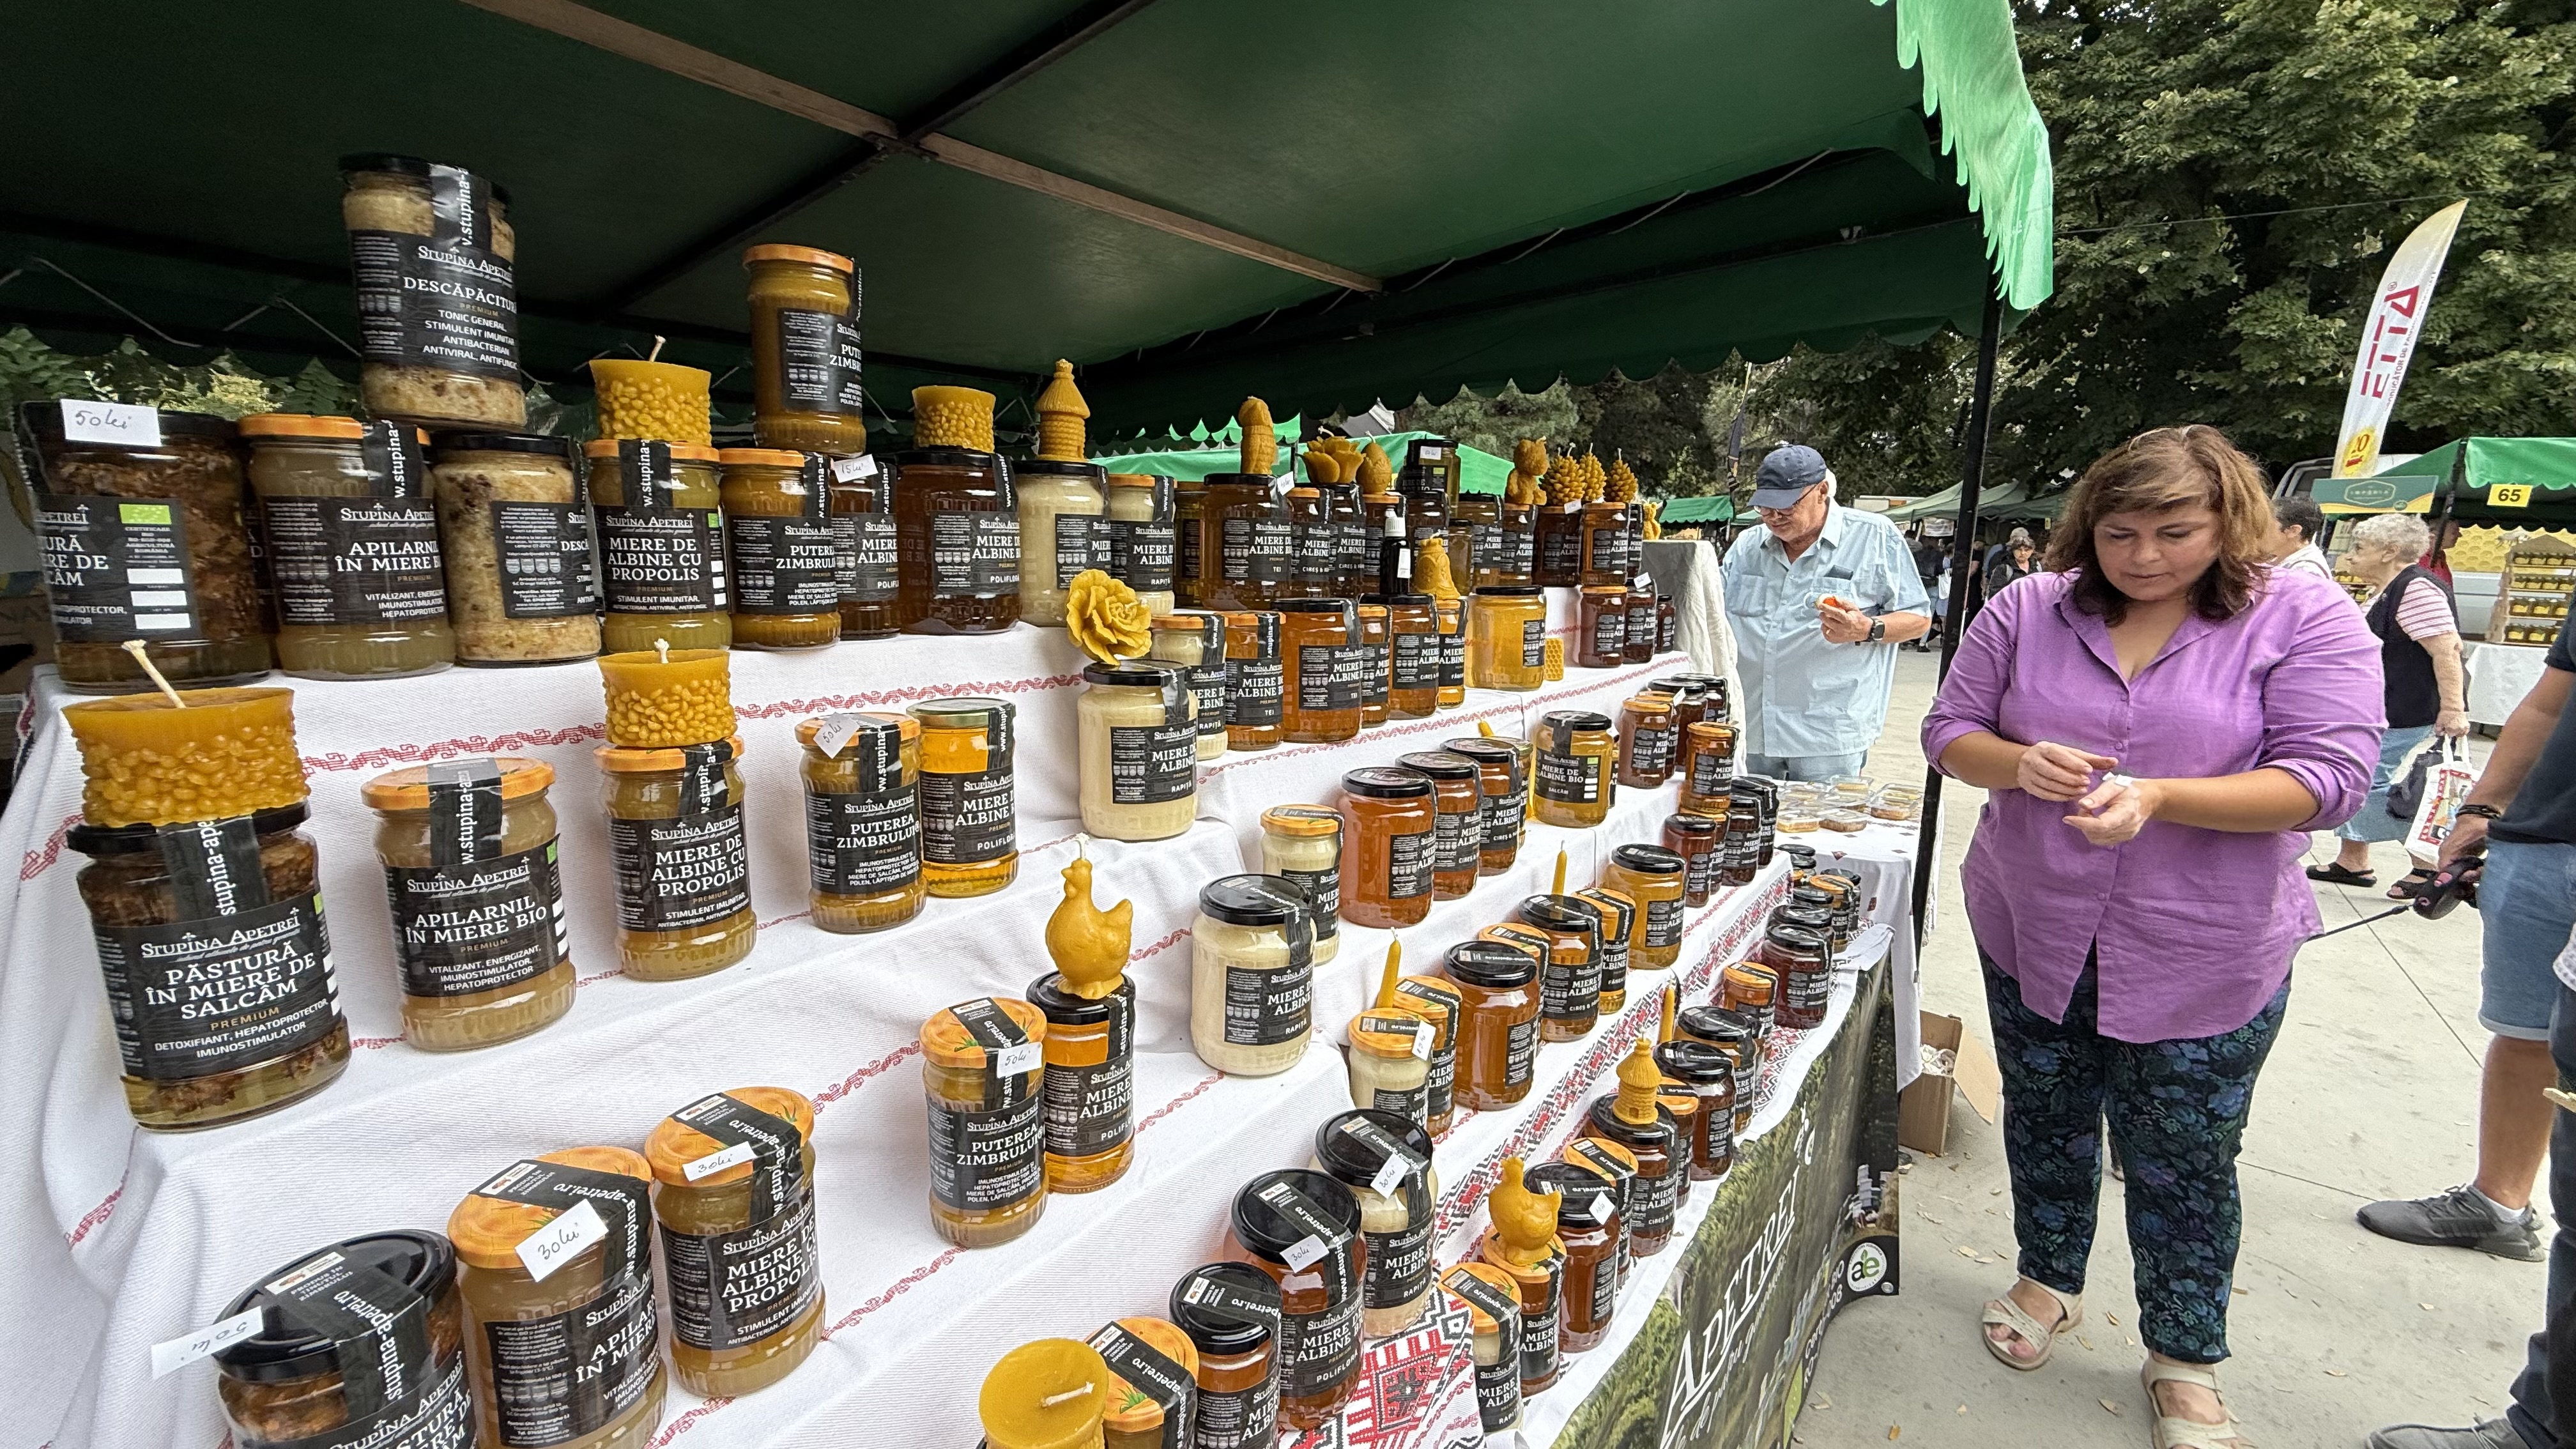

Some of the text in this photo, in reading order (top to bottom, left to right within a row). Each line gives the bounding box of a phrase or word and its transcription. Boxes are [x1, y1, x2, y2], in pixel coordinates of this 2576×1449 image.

[438, 310, 469, 322] TONIC
[460, 303, 498, 316] PREMIUM
[425, 321, 482, 337] STIMULENT
[443, 335, 509, 355] ANTIBACTERIAN
[2361, 285, 2419, 399] ETTA
[75, 410, 101, 426] 50
[2498, 489, 2520, 502] 65
[341, 508, 399, 520] STUPINA
[606, 515, 694, 528] STUPINA APETREI
[979, 519, 1005, 528] STUPINA
[610, 537, 696, 551] MIERE DE
[977, 536, 1013, 546] MIERE
[1133, 545, 1167, 554] MIERE
[1249, 546, 1284, 554] ALBINE
[76, 555, 109, 569] DE
[608, 554, 702, 567] ALBINE CU
[972, 548, 1013, 559] ALBINE
[1140, 555, 1172, 564] ALBINE
[335, 556, 429, 571] ÎN MIERE
[613, 568, 699, 581] PROPOLIS
[1334, 663, 1358, 671] MIERE
[1243, 678, 1275, 687] MIERE
[1329, 671, 1360, 682] ALBINE
[1237, 689, 1276, 697] ALBINE
[1154, 731, 1180, 740] STUPINA
[1152, 748, 1187, 762] MIERE
[1160, 757, 1194, 772] ALBINE
[1542, 763, 1565, 774] MIERE
[964, 779, 998, 790] STUPINA
[1540, 771, 1566, 782] ALBINE
[845, 802, 884, 813] STUPINA
[963, 795, 1008, 812] MIERE
[1496, 808, 1517, 817] MIERE
[851, 814, 914, 834] PUTEREA
[955, 808, 1009, 825] ALBINE
[1492, 815, 1518, 825] ALBINE
[651, 815, 739, 839] STUPINA APETREI
[656, 834, 742, 866] MIERE DE
[651, 847, 745, 881] ALBINE CU
[407, 879, 465, 891] STUPINA
[472, 864, 530, 885] APETREI
[658, 863, 745, 897] PROPOLIS
[693, 891, 728, 904] PREMIUM
[415, 896, 535, 928] APILARNIL
[666, 905, 714, 919] STIMULENT
[406, 907, 547, 944] ÎN MIERE BIO
[141, 938, 224, 957] STUPINA
[229, 916, 300, 944] APETREI
[461, 939, 508, 953] PREMIUM
[165, 940, 297, 986] PĂSTURĂ
[145, 953, 316, 1006] ÎN MIERE DE
[444, 965, 533, 991] HEPATOPROTECTOR
[181, 979, 298, 1020] SALCÂM
[1268, 986, 1305, 1005] MIERE
[1275, 992, 1310, 1016] ALBINE
[211, 1007, 280, 1031] PREMIUM
[235, 999, 328, 1039] HEPATOPROTECTOR
[196, 1021, 306, 1057] IMUNOSTIMULATOR
[1086, 1077, 1130, 1105] MIERE
[1080, 1089, 1131, 1119] ALBINE
[967, 1119, 1006, 1131] STUPINA
[972, 1123, 1038, 1153] PUTEREA
[698, 1162, 717, 1173] 30
[995, 1160, 1023, 1172] PREMIUM
[538, 1241, 560, 1260] 30
[723, 1232, 776, 1255] STUPINA
[727, 1215, 815, 1281] MIERE DE
[1386, 1246, 1425, 1269] MIERE
[1392, 1252, 1431, 1278] ALBINE
[721, 1252, 801, 1298] ALBINE
[729, 1248, 817, 1312] PROPOLIS
[586, 1285, 639, 1327] STUPINA
[767, 1287, 802, 1311] PREMIUM
[737, 1306, 790, 1335] STIMULENT
[1303, 1309, 1363, 1348] MIERE DE
[1308, 1312, 1340, 1330] STUPINA
[1296, 1335, 1351, 1361] ALBINE
[575, 1360, 603, 1383] ÎN
[418, 1358, 463, 1415] APETREI
[1478, 1379, 1515, 1398] MIERE
[459, 1389, 471, 1421] DE
